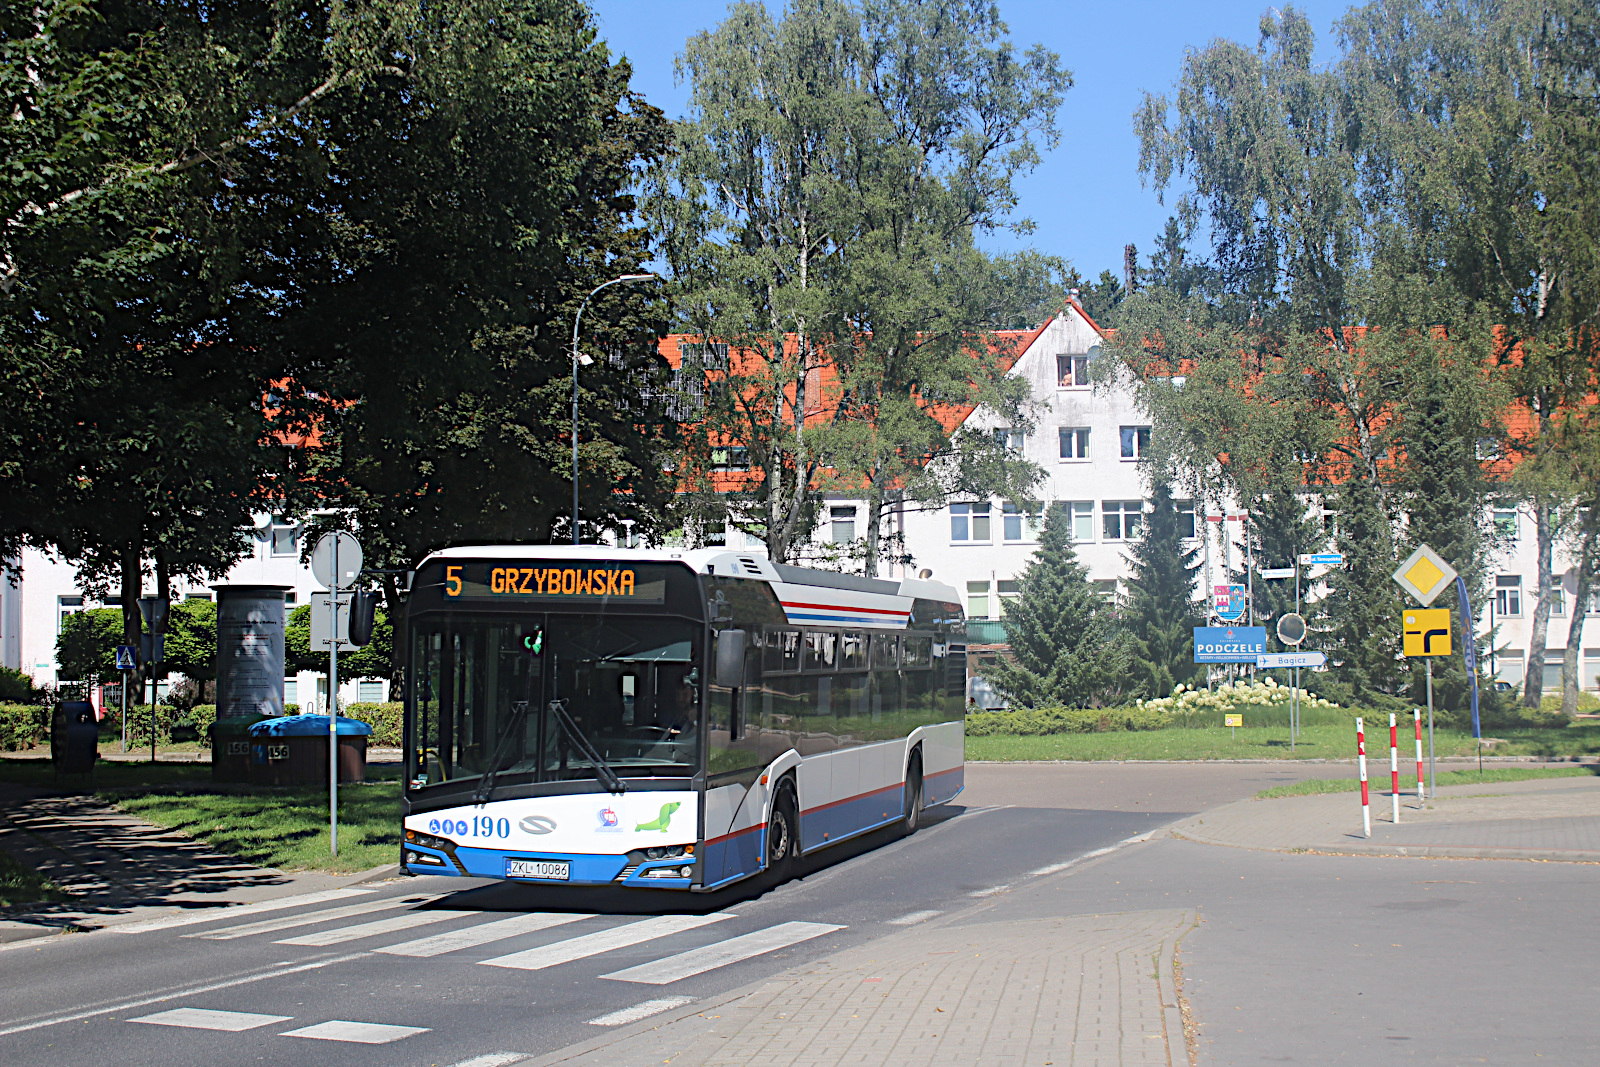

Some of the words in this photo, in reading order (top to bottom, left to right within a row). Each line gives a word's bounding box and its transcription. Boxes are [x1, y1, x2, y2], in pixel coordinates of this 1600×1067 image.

[446, 565, 462, 596] 5
[491, 568, 635, 596] GRZYBOWSKA
[1197, 643, 1262, 653] PODCZELE
[1278, 657, 1306, 666] Bagicz
[229, 743, 249, 754] 156
[269, 746, 288, 758] 156
[472, 815, 510, 838] 190
[512, 861, 531, 874] ZKL
[536, 863, 567, 876] 10086
